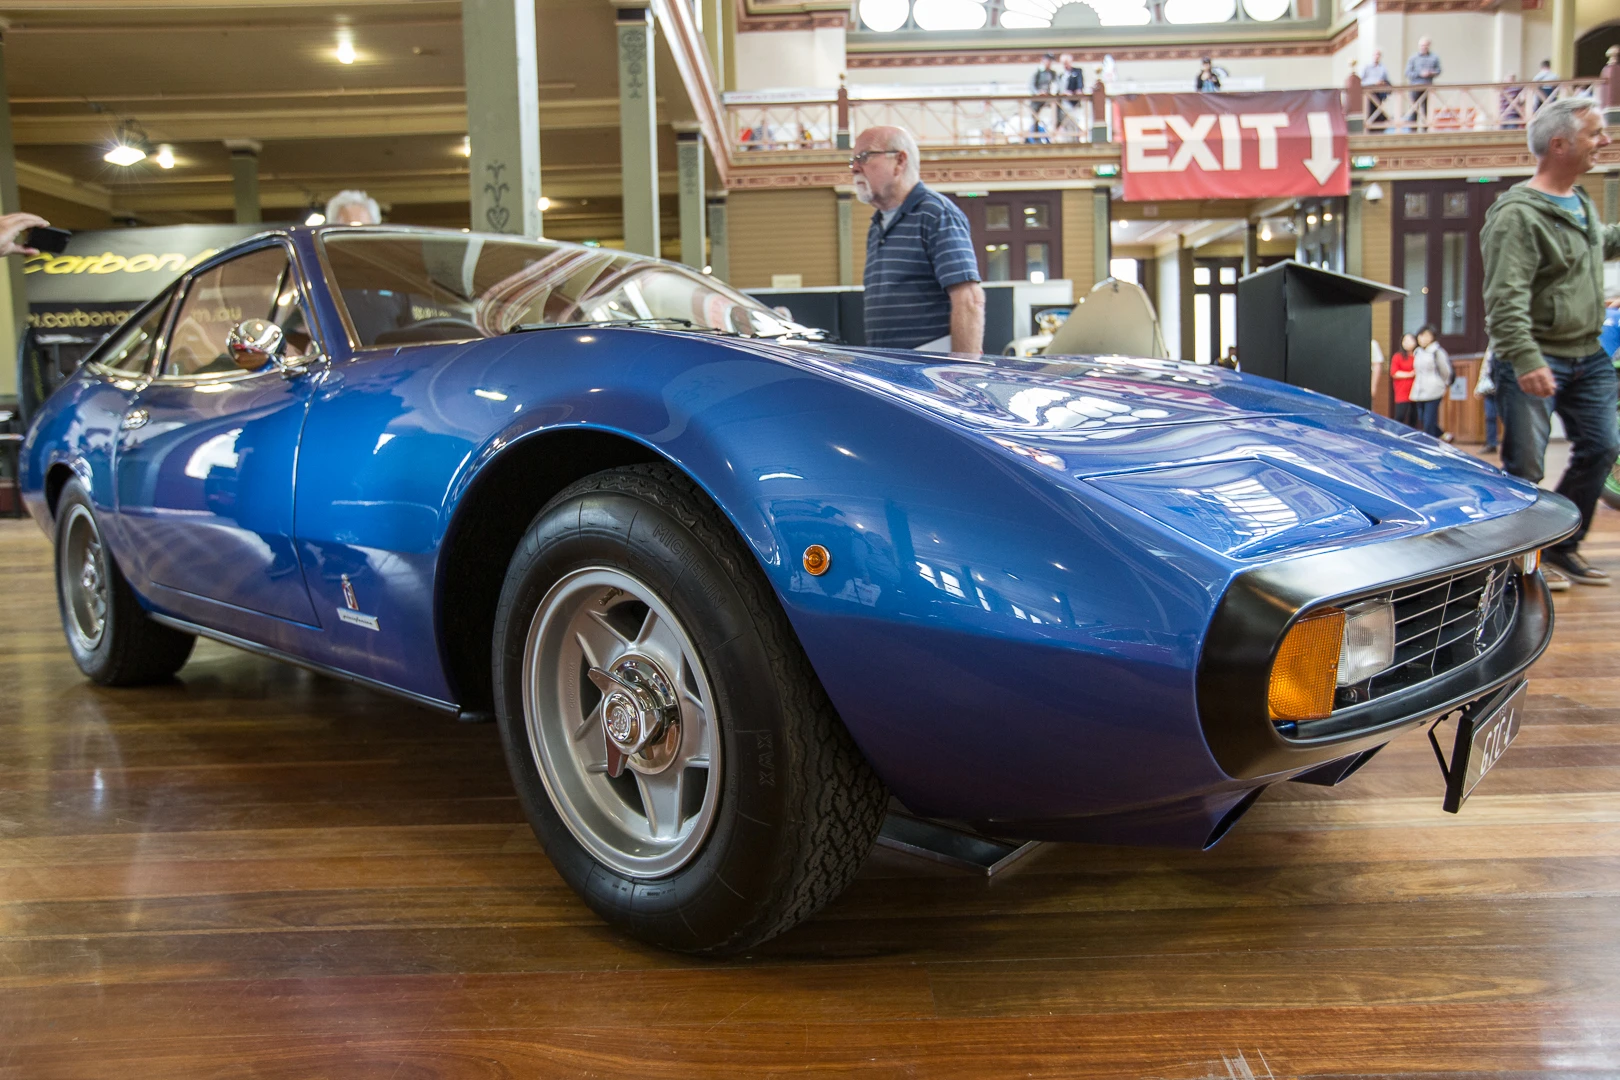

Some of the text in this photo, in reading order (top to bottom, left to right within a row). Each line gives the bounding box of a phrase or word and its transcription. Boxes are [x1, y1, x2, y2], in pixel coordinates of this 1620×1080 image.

[1123, 112, 1290, 173] EXIT
[24, 249, 214, 275] carbon
[652, 523, 726, 610] MICHELIN
[757, 732, 775, 787] XWX
